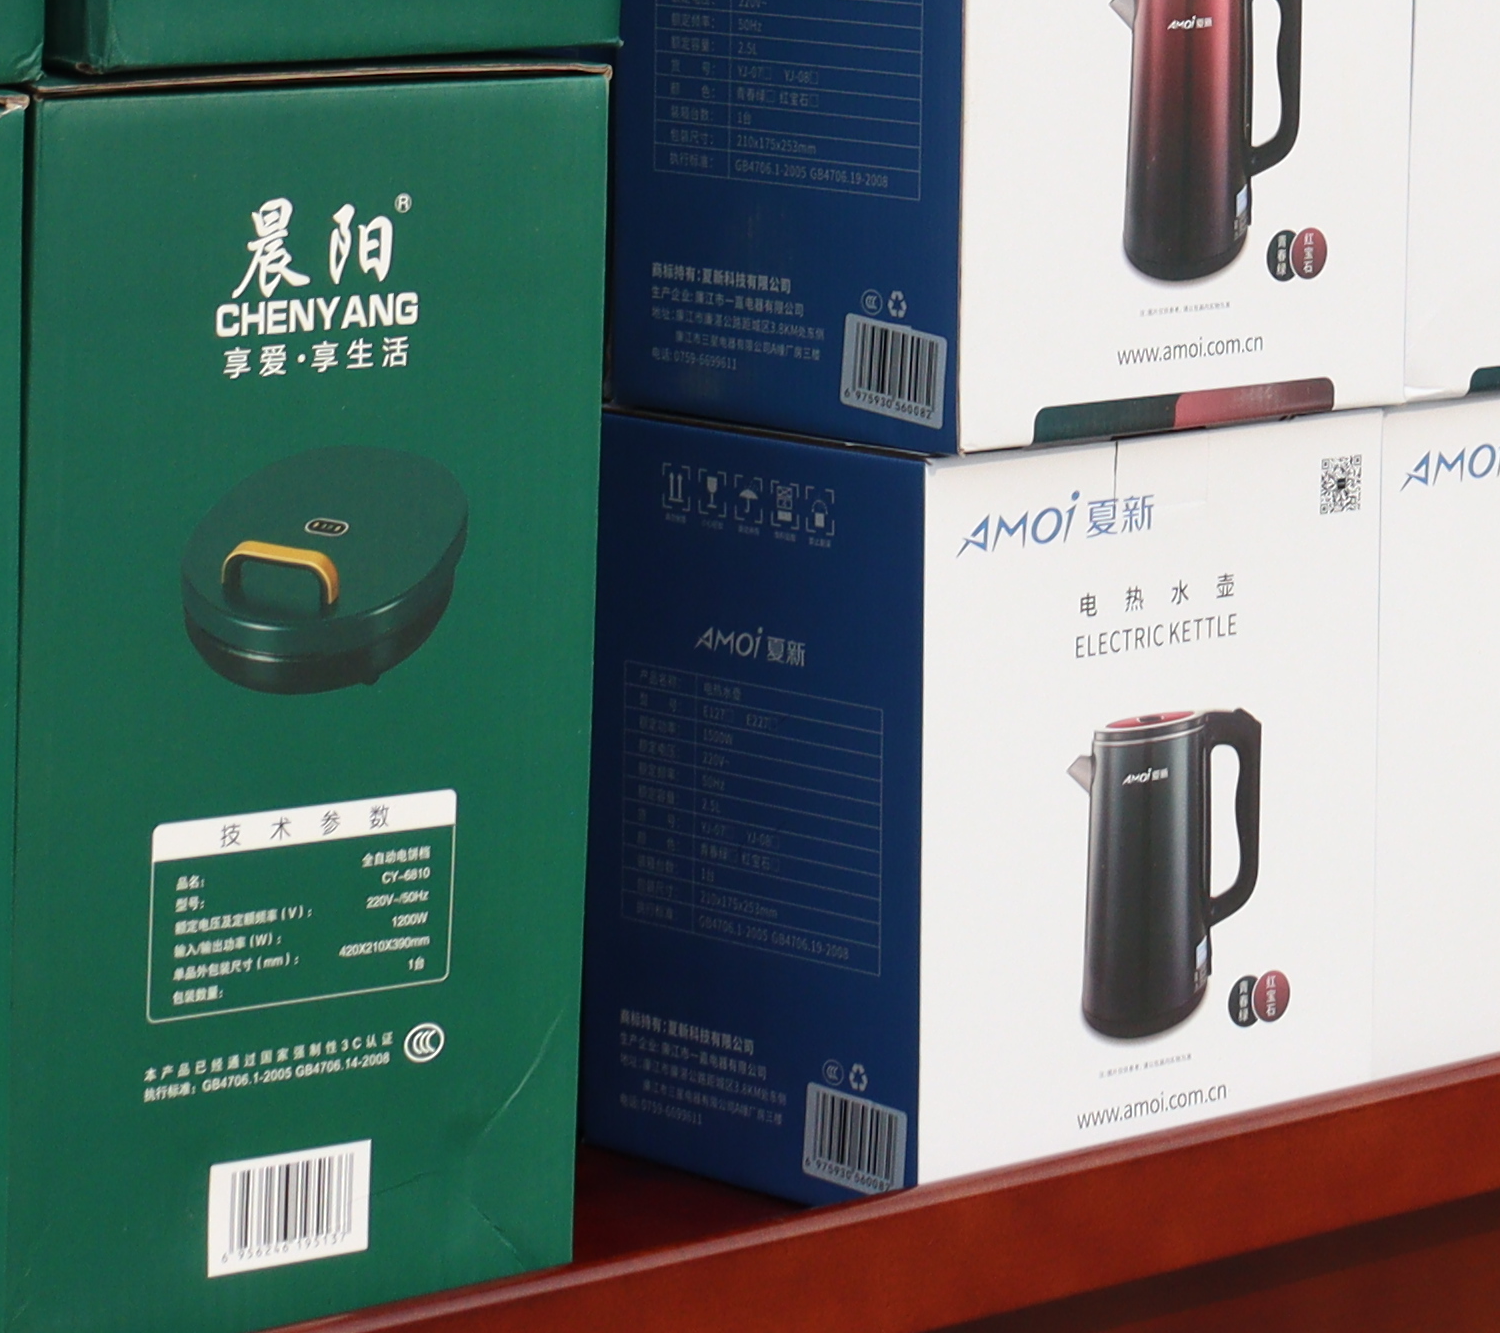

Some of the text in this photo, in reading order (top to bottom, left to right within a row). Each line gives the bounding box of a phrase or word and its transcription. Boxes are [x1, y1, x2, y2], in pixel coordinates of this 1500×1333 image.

[232, 198, 394, 299] 晨阳
[215, 292, 419, 338] CHENYANG
[223, 336, 410, 380] 享爱·享生活
[1116, 335, 1264, 367] www.amoi.com.cn
[1087, 493, 1154, 536] 夏新
[1079, 573, 1235, 618] 电热水壶
[1074, 612, 1238, 659] ELECTRIC KETTLE
[220, 804, 390, 848] 技术参数
[1077, 1083, 1227, 1130] www.amoi.com.cn
